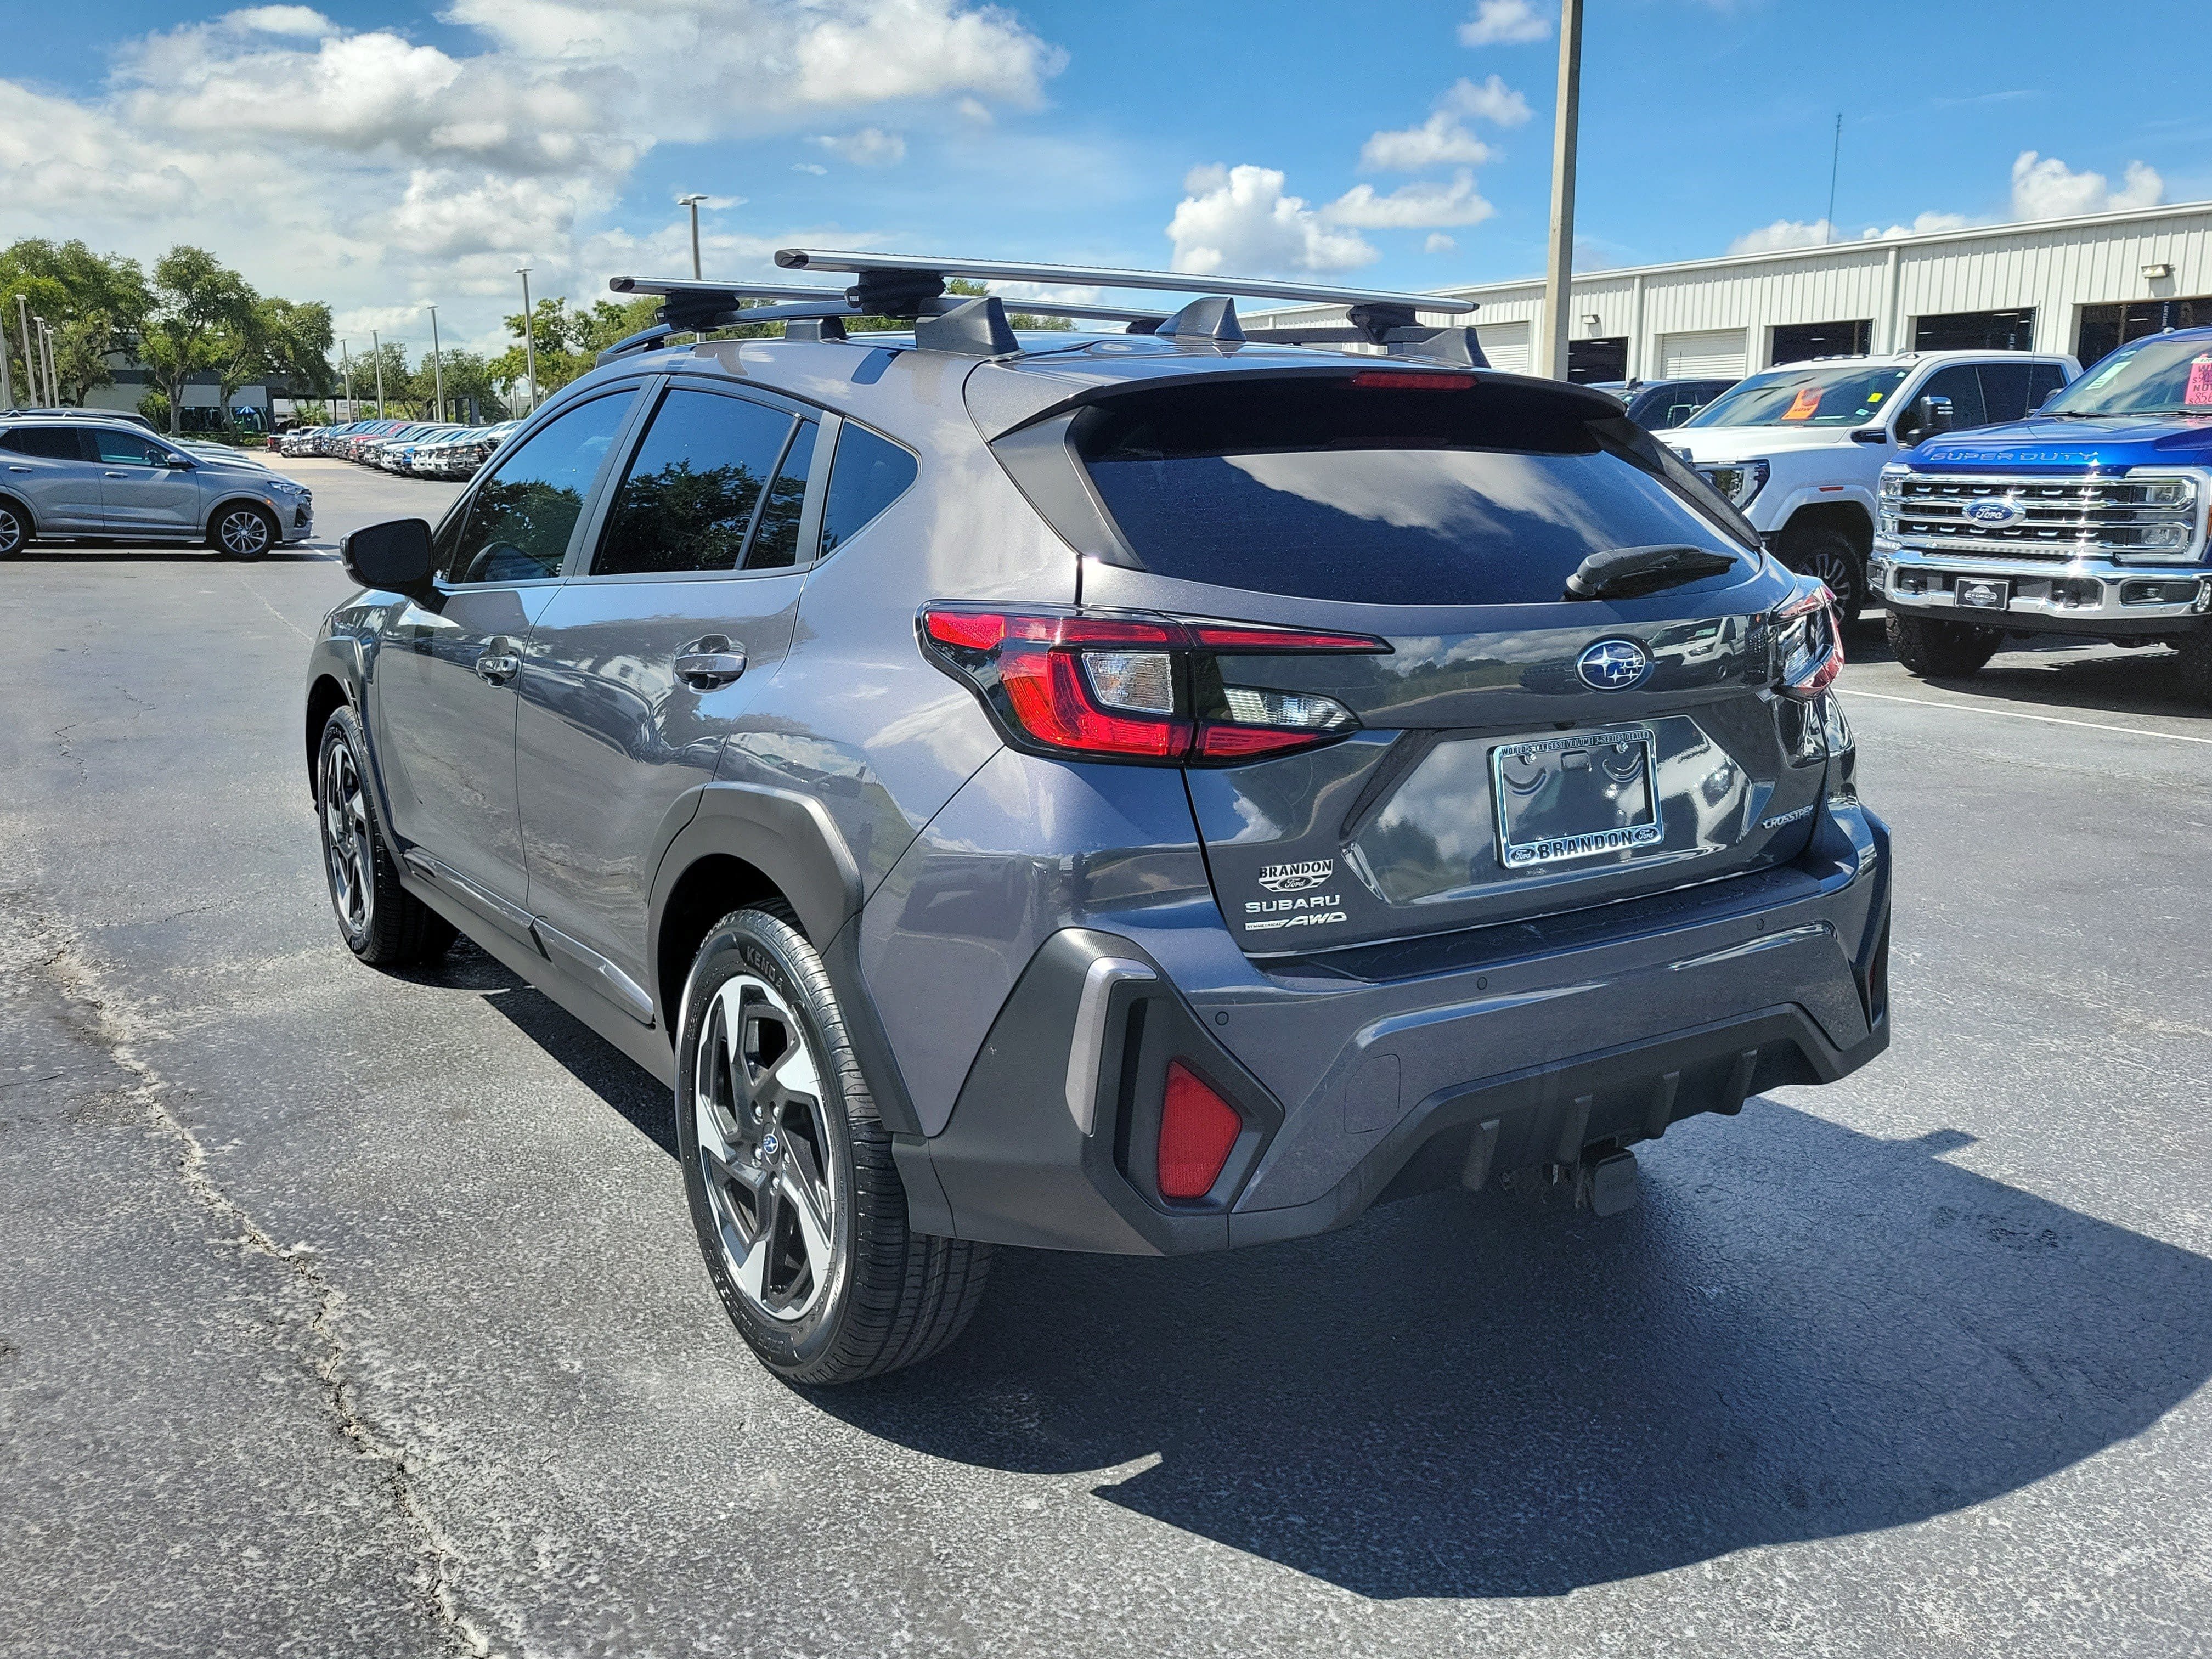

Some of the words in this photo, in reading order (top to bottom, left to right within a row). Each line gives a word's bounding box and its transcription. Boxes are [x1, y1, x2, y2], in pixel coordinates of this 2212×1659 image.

[1930, 452, 2014, 461] SUPER
[2020, 452, 2098, 461] DUTY
[1976, 505, 2005, 519] Ford
[1502, 744, 1533, 755] WORLD'S
[1535, 741, 1565, 752] LARGEST
[1566, 737, 1593, 747] VOLUME
[1594, 734, 1624, 744] F-SERIES
[1625, 731, 1649, 741] DEALER
[1638, 830, 1655, 840] Ford
[1537, 831, 1633, 859] BRANDON
[1514, 850, 1532, 860] Ford
[1259, 860, 1333, 878] BRANDON
[1284, 879, 1306, 888] Ford
[1245, 895, 1340, 913] SUBARU
[1284, 912, 1347, 927] AWD
[747, 946, 783, 994] KENDA
